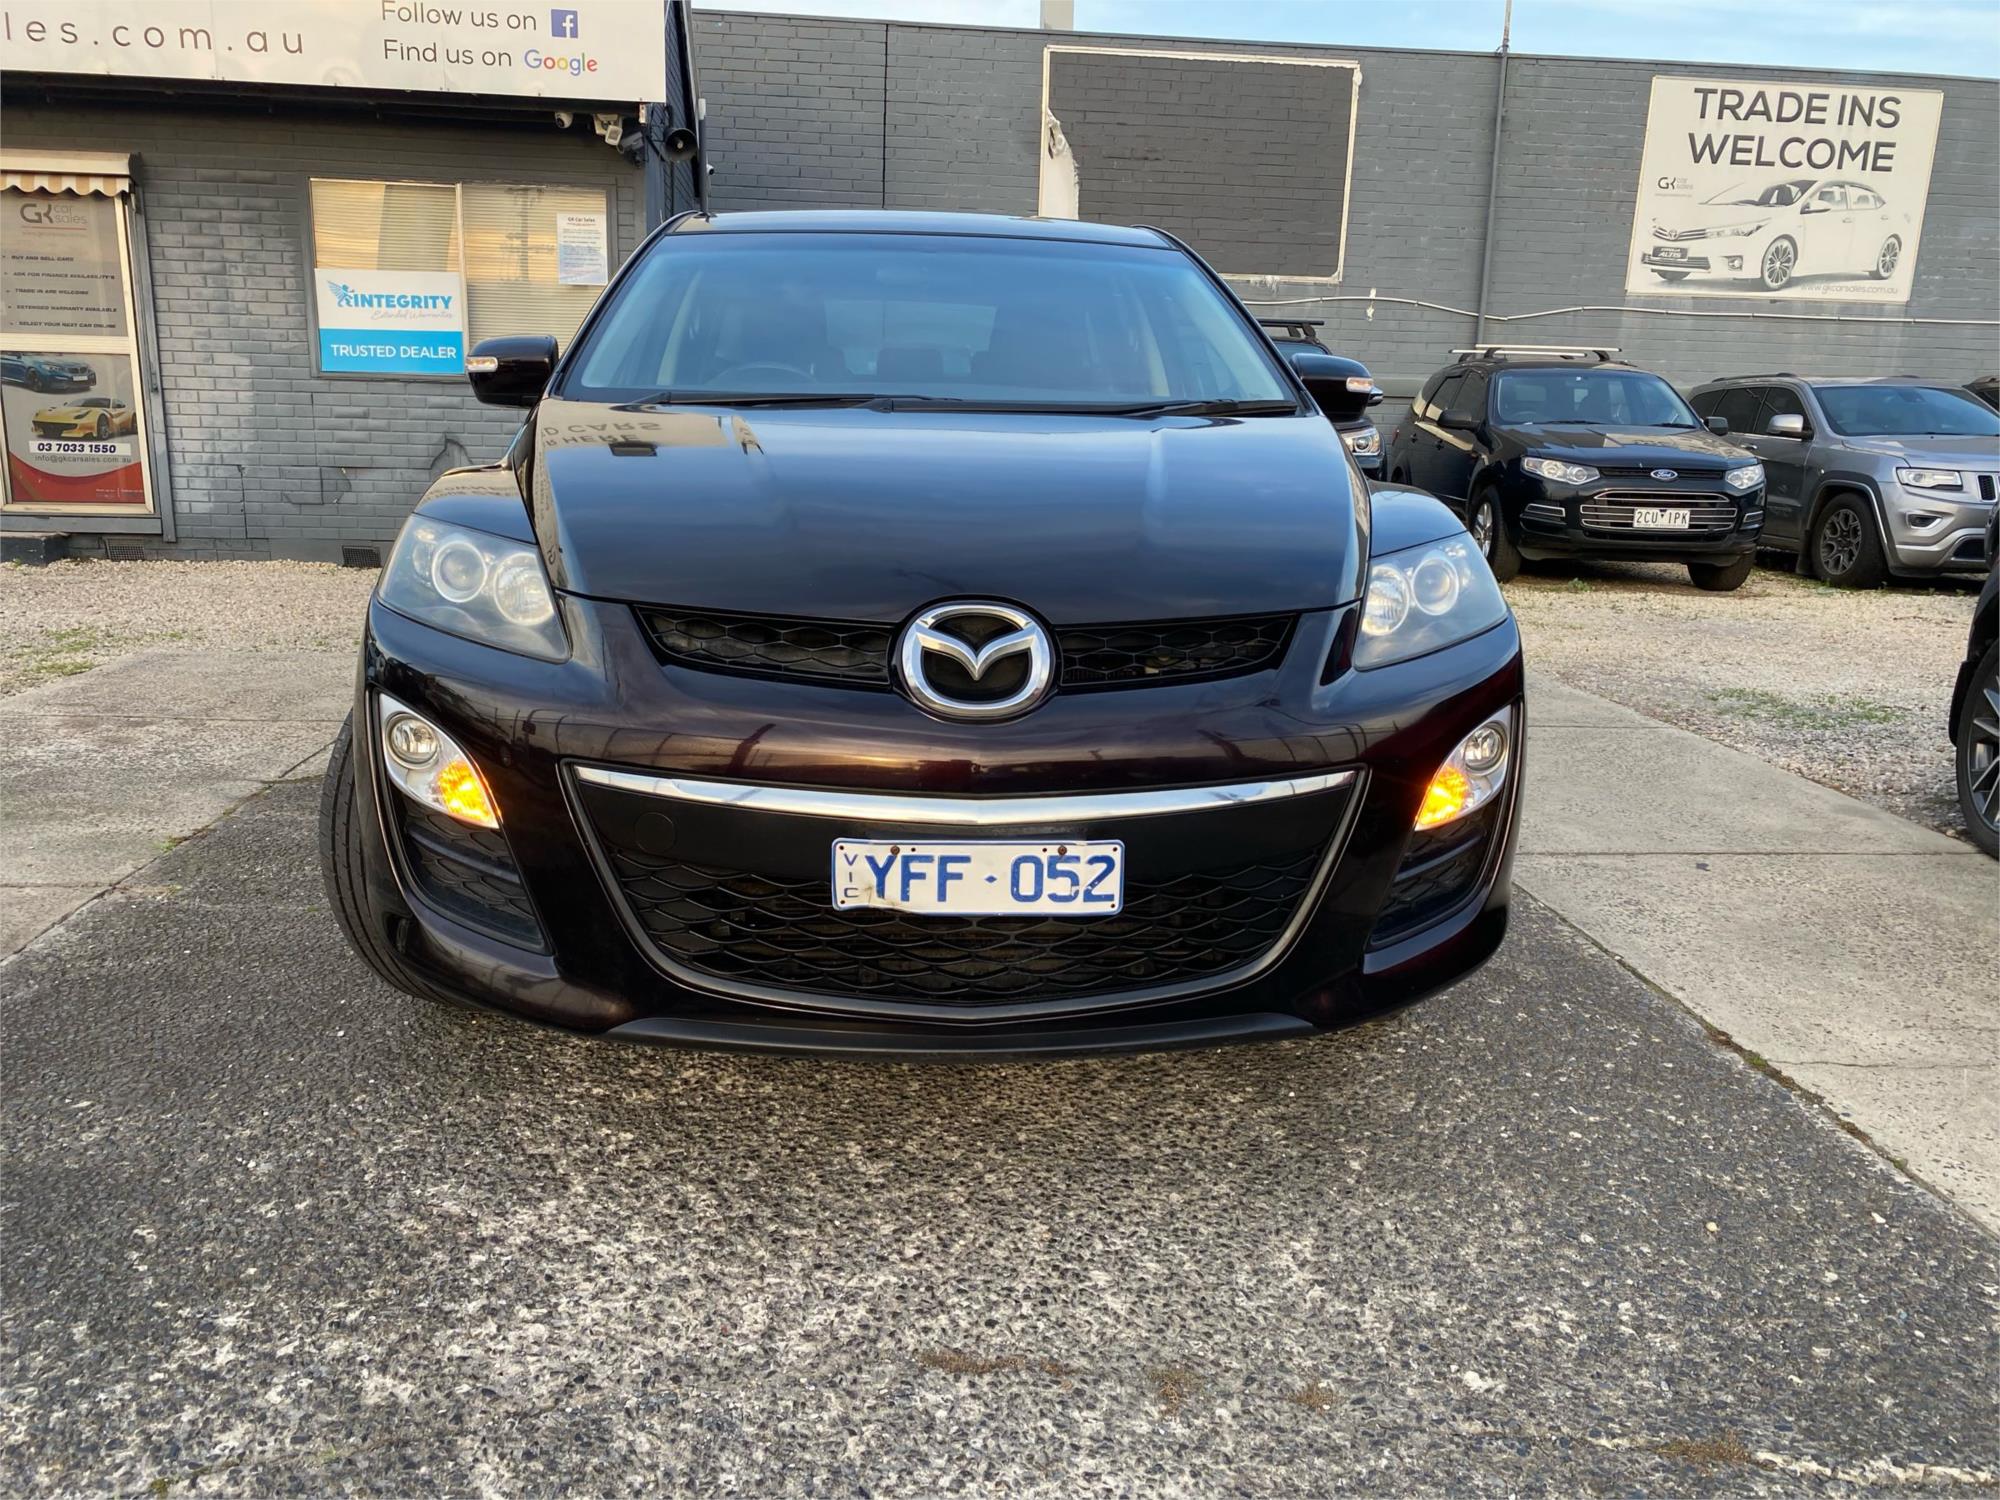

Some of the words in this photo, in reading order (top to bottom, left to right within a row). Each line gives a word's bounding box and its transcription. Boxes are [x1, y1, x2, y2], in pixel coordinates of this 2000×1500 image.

[4, 12, 304, 54] les.com.au
[381, 0, 463, 26] Follow
[470, 11, 499, 28] us
[506, 13, 537, 31] on
[383, 39, 438, 63] Find
[445, 48, 474, 65] us
[481, 50, 512, 67] on
[524, 49, 599, 77] Google
[1693, 87, 1830, 125] TRADE
[1836, 94, 1902, 129] INS
[1687, 132, 1897, 172] WELCOME
[353, 293, 453, 309] INTEGRITY
[330, 344, 397, 358] TRUSTED
[400, 345, 457, 359] DEALER
[37, 442, 53, 452] 03
[55, 443, 85, 453] 7033
[88, 444, 117, 454] 1550
[1636, 511, 1659, 524] 2CU
[1668, 511, 1688, 525] 1PK
[843, 853, 859, 899] VIC
[864, 854, 972, 903] YFF
[1010, 854, 1117, 904] 052
